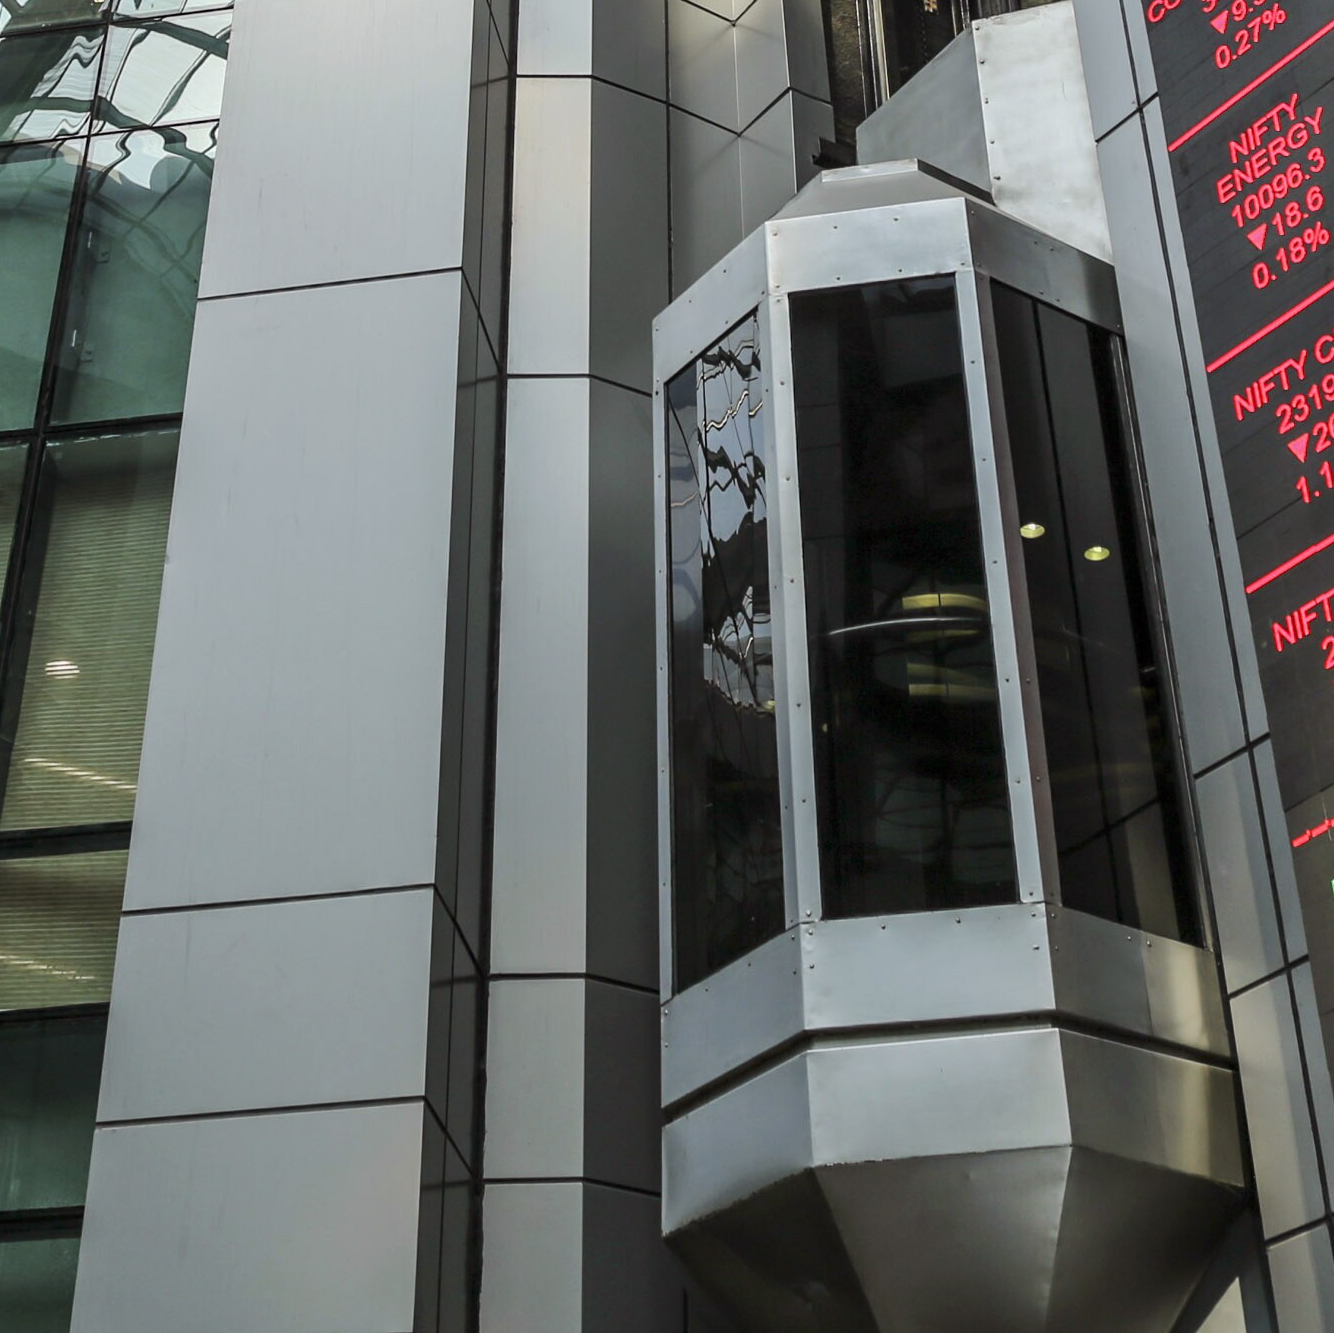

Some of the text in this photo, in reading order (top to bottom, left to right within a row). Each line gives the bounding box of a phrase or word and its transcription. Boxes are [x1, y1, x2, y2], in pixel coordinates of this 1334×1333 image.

[1215, 3, 1287, 68] 0.27%
[1217, 107, 1323, 203] ENERGY
[1229, 93, 1299, 163] NIFTY
[1231, 148, 1325, 227] 10096.3
[1272, 186, 1323, 236] 18.6
[1252, 222, 1330, 289] 0.18%
[1233, 349, 1307, 421] NIFTY
